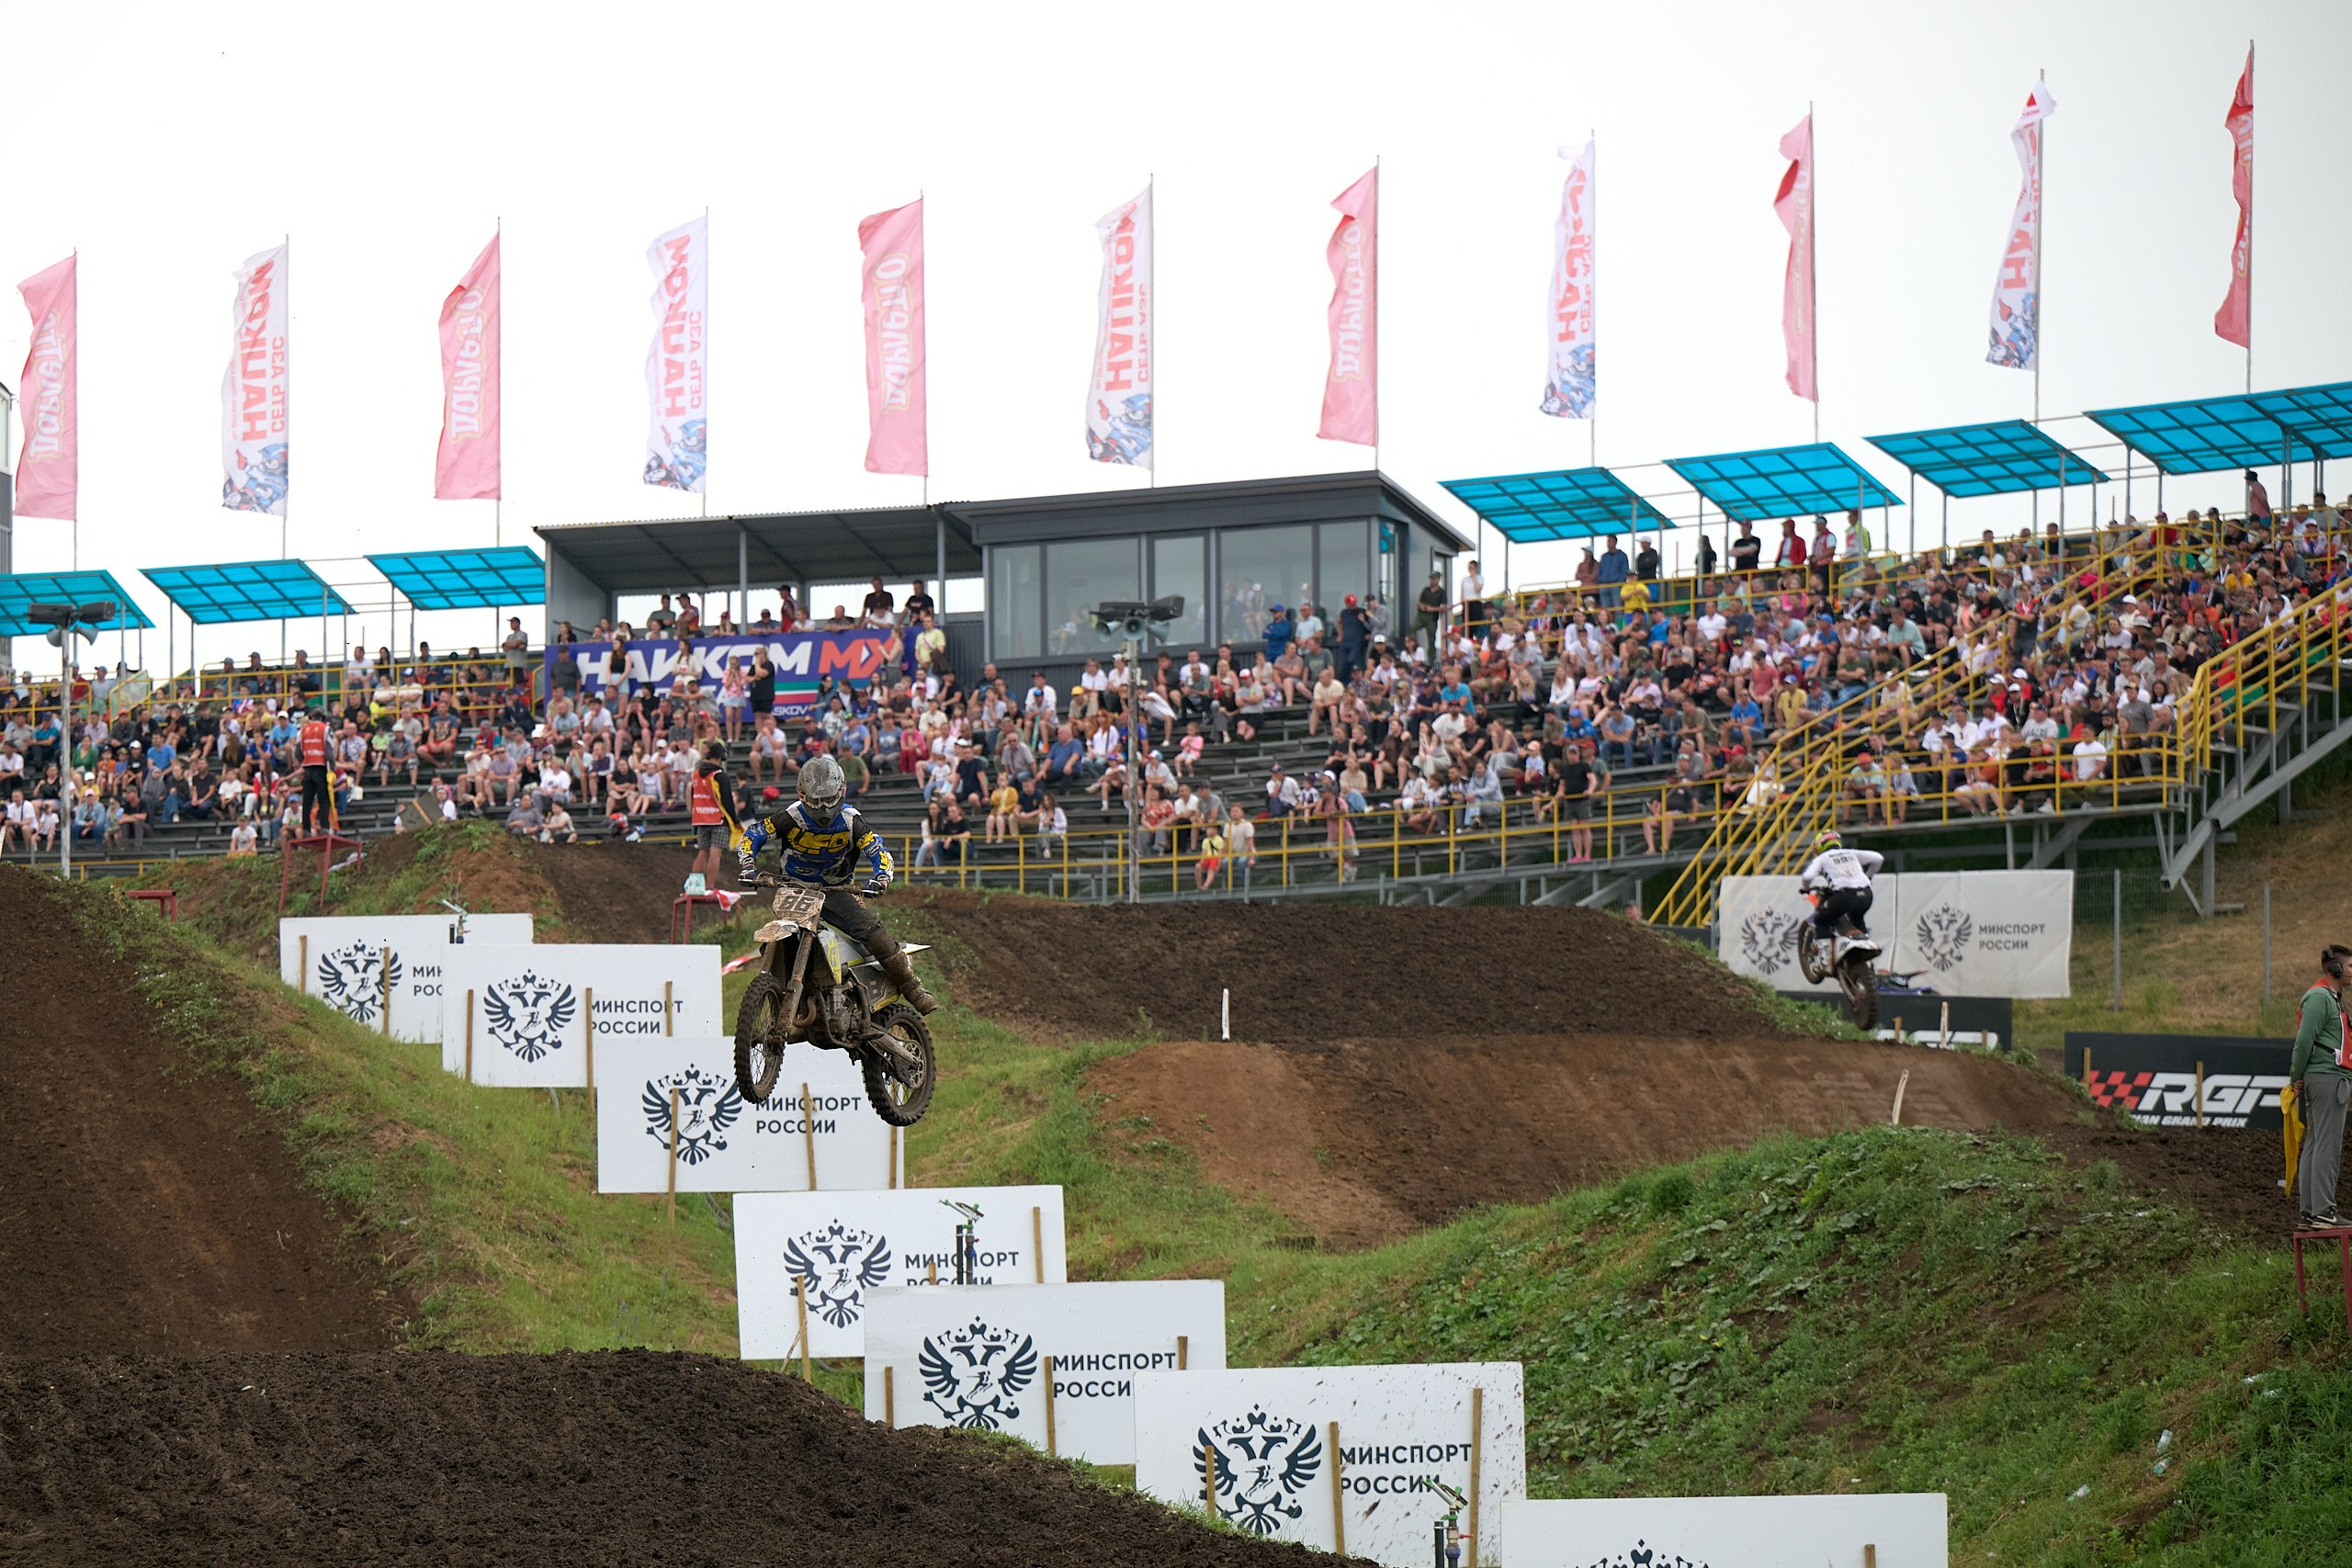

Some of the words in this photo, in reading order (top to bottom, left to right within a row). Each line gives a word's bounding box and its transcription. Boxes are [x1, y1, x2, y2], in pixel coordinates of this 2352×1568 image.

[787, 827, 851, 854] UFO
[1978, 923, 2045, 935] МИНСПОРТ
[1979, 940, 2028, 951] РОССИИ
[756, 1120, 835, 1134] РОССИИ
[2211, 1117, 2247, 1128] PRIX
[1052, 1353, 1176, 1371] МИНСПОРТ
[1340, 1444, 1472, 1465] МИНСПОРТ
